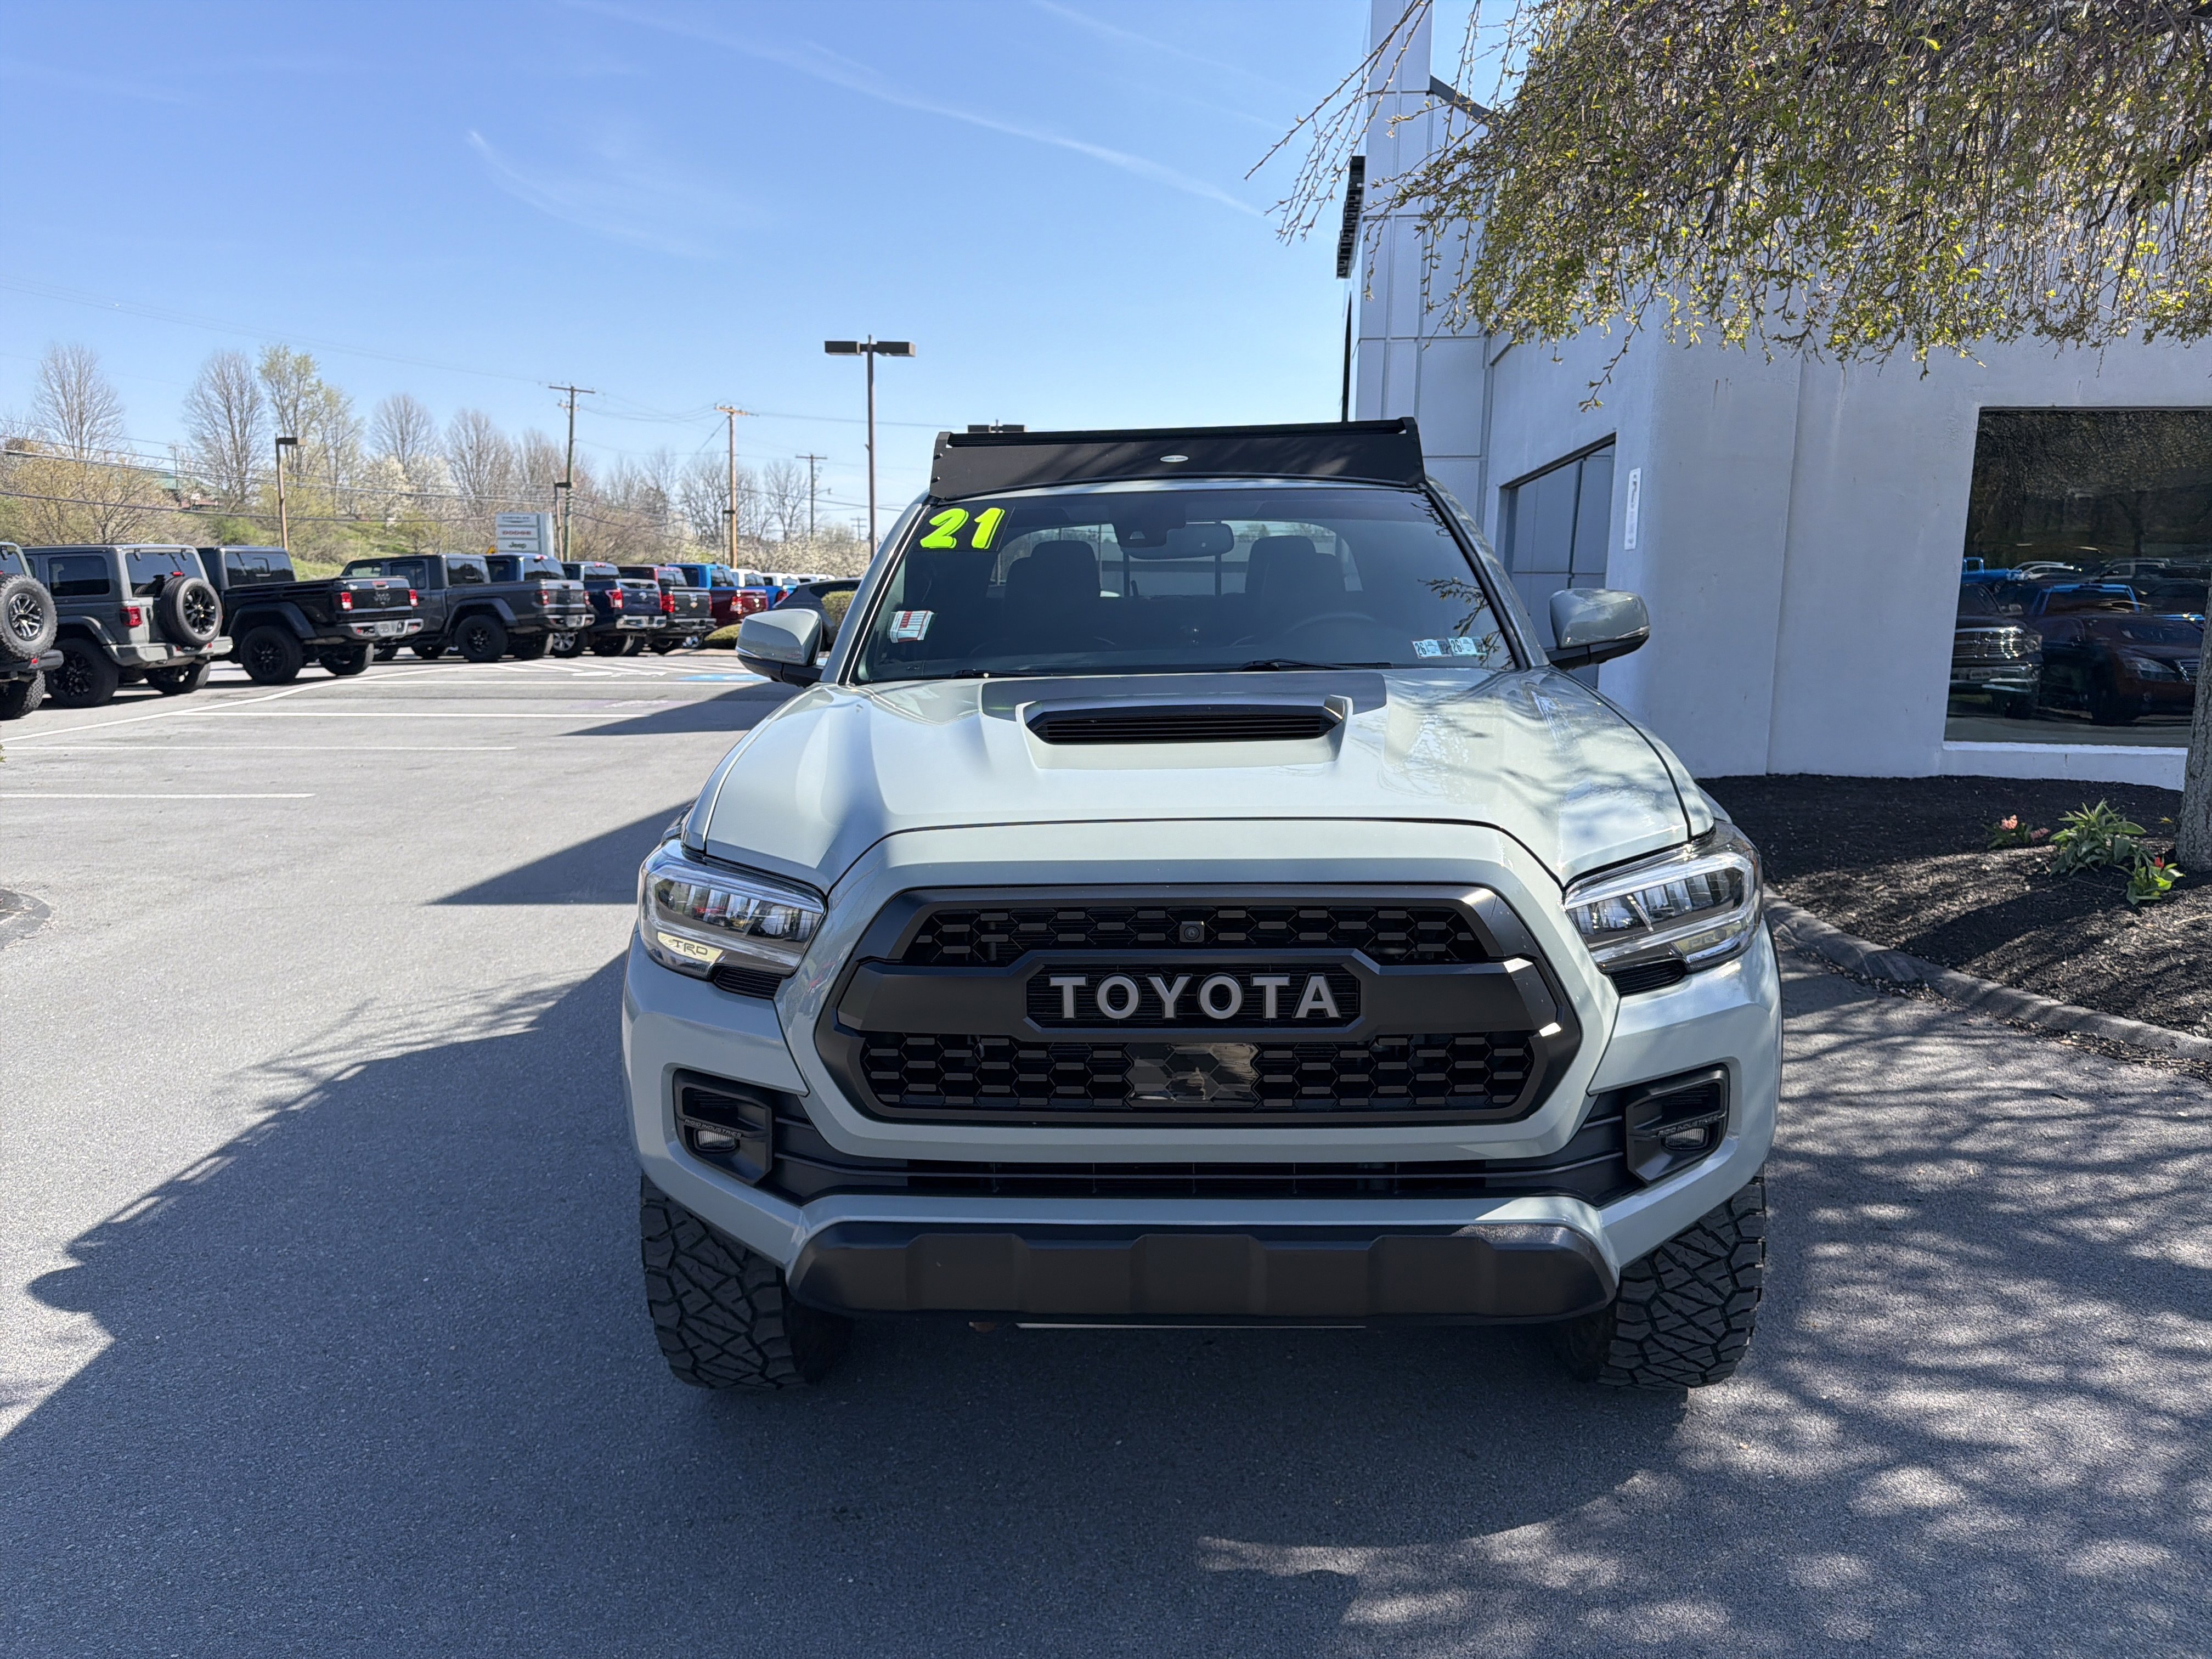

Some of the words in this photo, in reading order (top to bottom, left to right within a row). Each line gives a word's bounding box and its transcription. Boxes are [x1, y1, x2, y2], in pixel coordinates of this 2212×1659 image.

[920, 507, 1006, 549] 21
[1415, 642, 1427, 656] 26
[1450, 639, 1463, 653] 26
[670, 938, 708, 956] TRD
[1048, 973, 1342, 1019] TOYOTA
